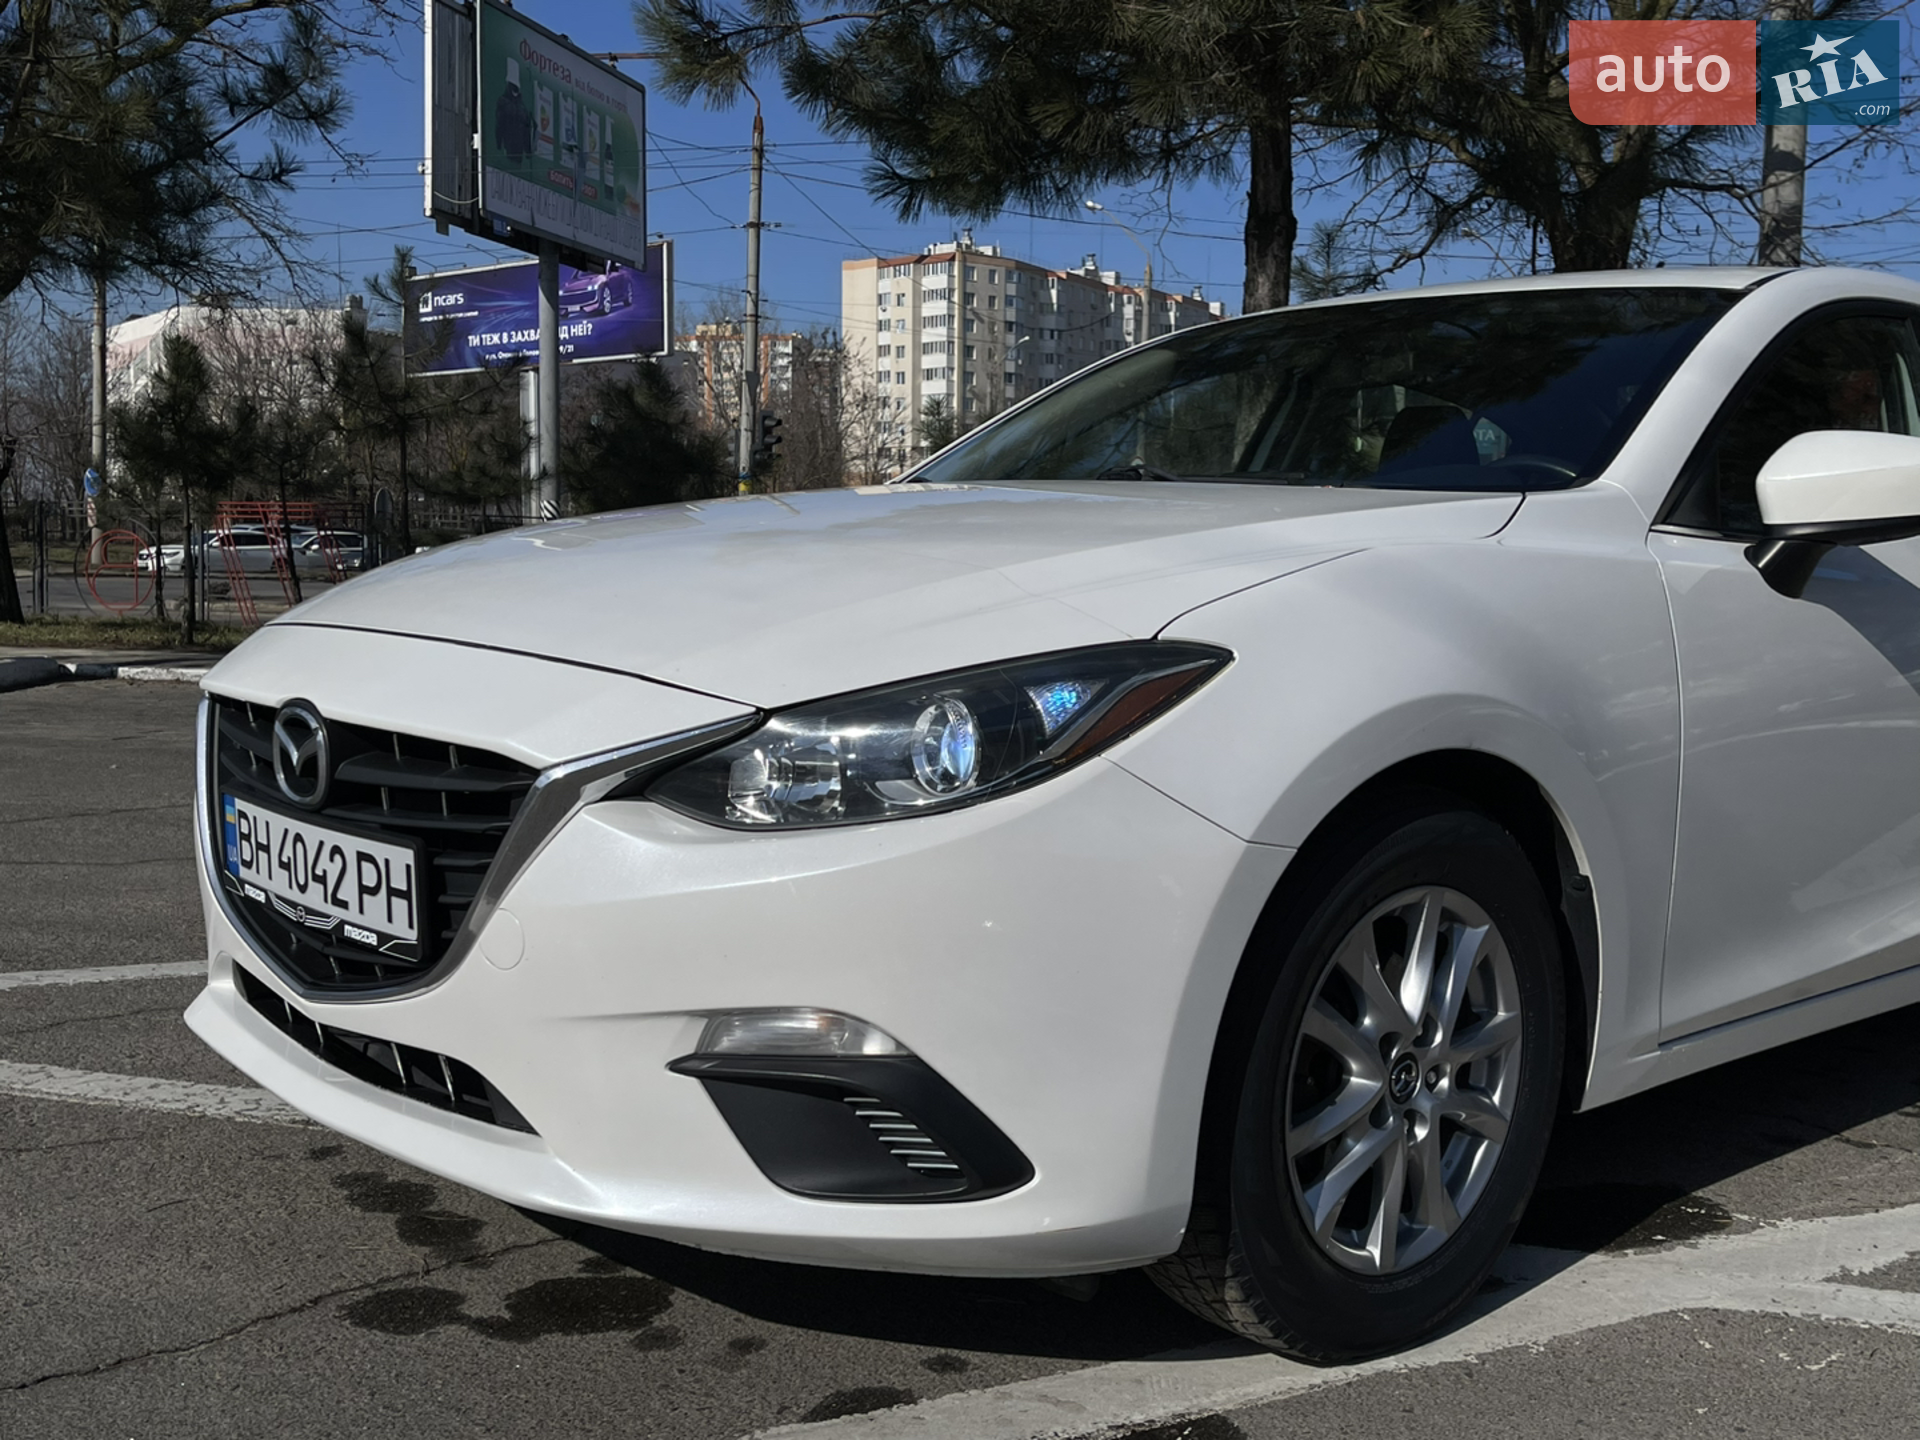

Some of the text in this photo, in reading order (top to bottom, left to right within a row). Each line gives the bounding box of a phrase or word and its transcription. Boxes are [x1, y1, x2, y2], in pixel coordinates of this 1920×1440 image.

[520, 38, 572, 83] Фортеза
[433, 292, 465, 307] ncars
[467, 334, 480, 348] ТИ
[481, 333, 501, 346] ТЕЖ
[502, 332, 509, 344] В
[510, 328, 541, 344] ЗАХВА
[570, 320, 593, 337] НЕЇ?
[1473, 428, 1496, 441] TA
[227, 843, 239, 865] UA
[237, 808, 415, 931] BH 4042 PH
[344, 924, 378, 947] mazda
